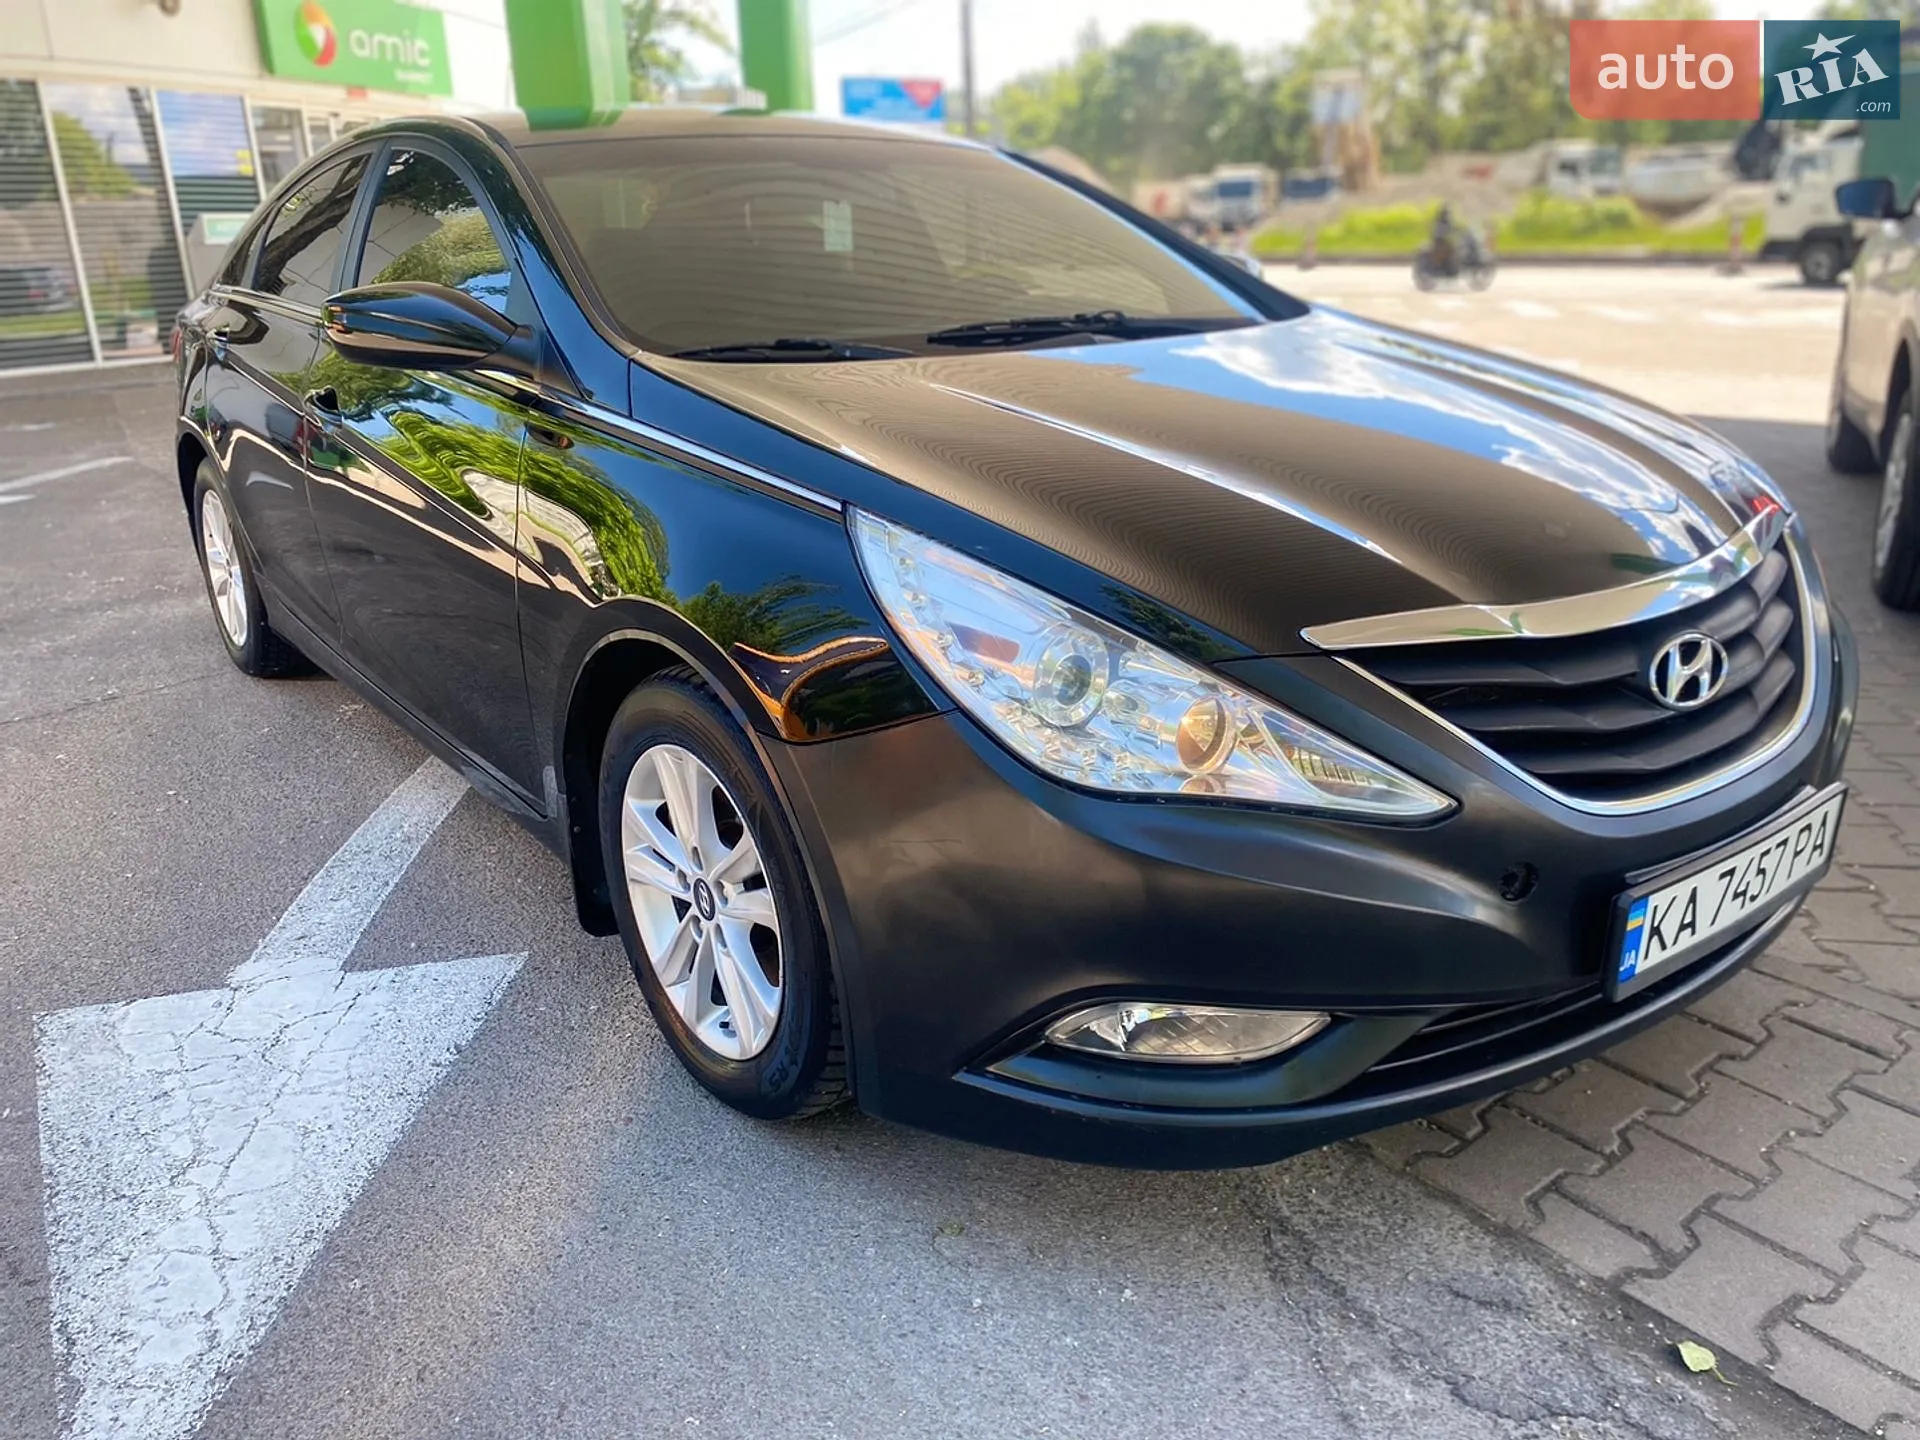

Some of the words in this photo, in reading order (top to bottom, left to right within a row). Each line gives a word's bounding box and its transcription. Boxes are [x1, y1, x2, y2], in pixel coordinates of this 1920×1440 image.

[348, 28, 431, 66] amic
[1643, 885, 1698, 961] KA
[1709, 835, 1789, 927] 7457
[1787, 810, 1829, 880] PA
